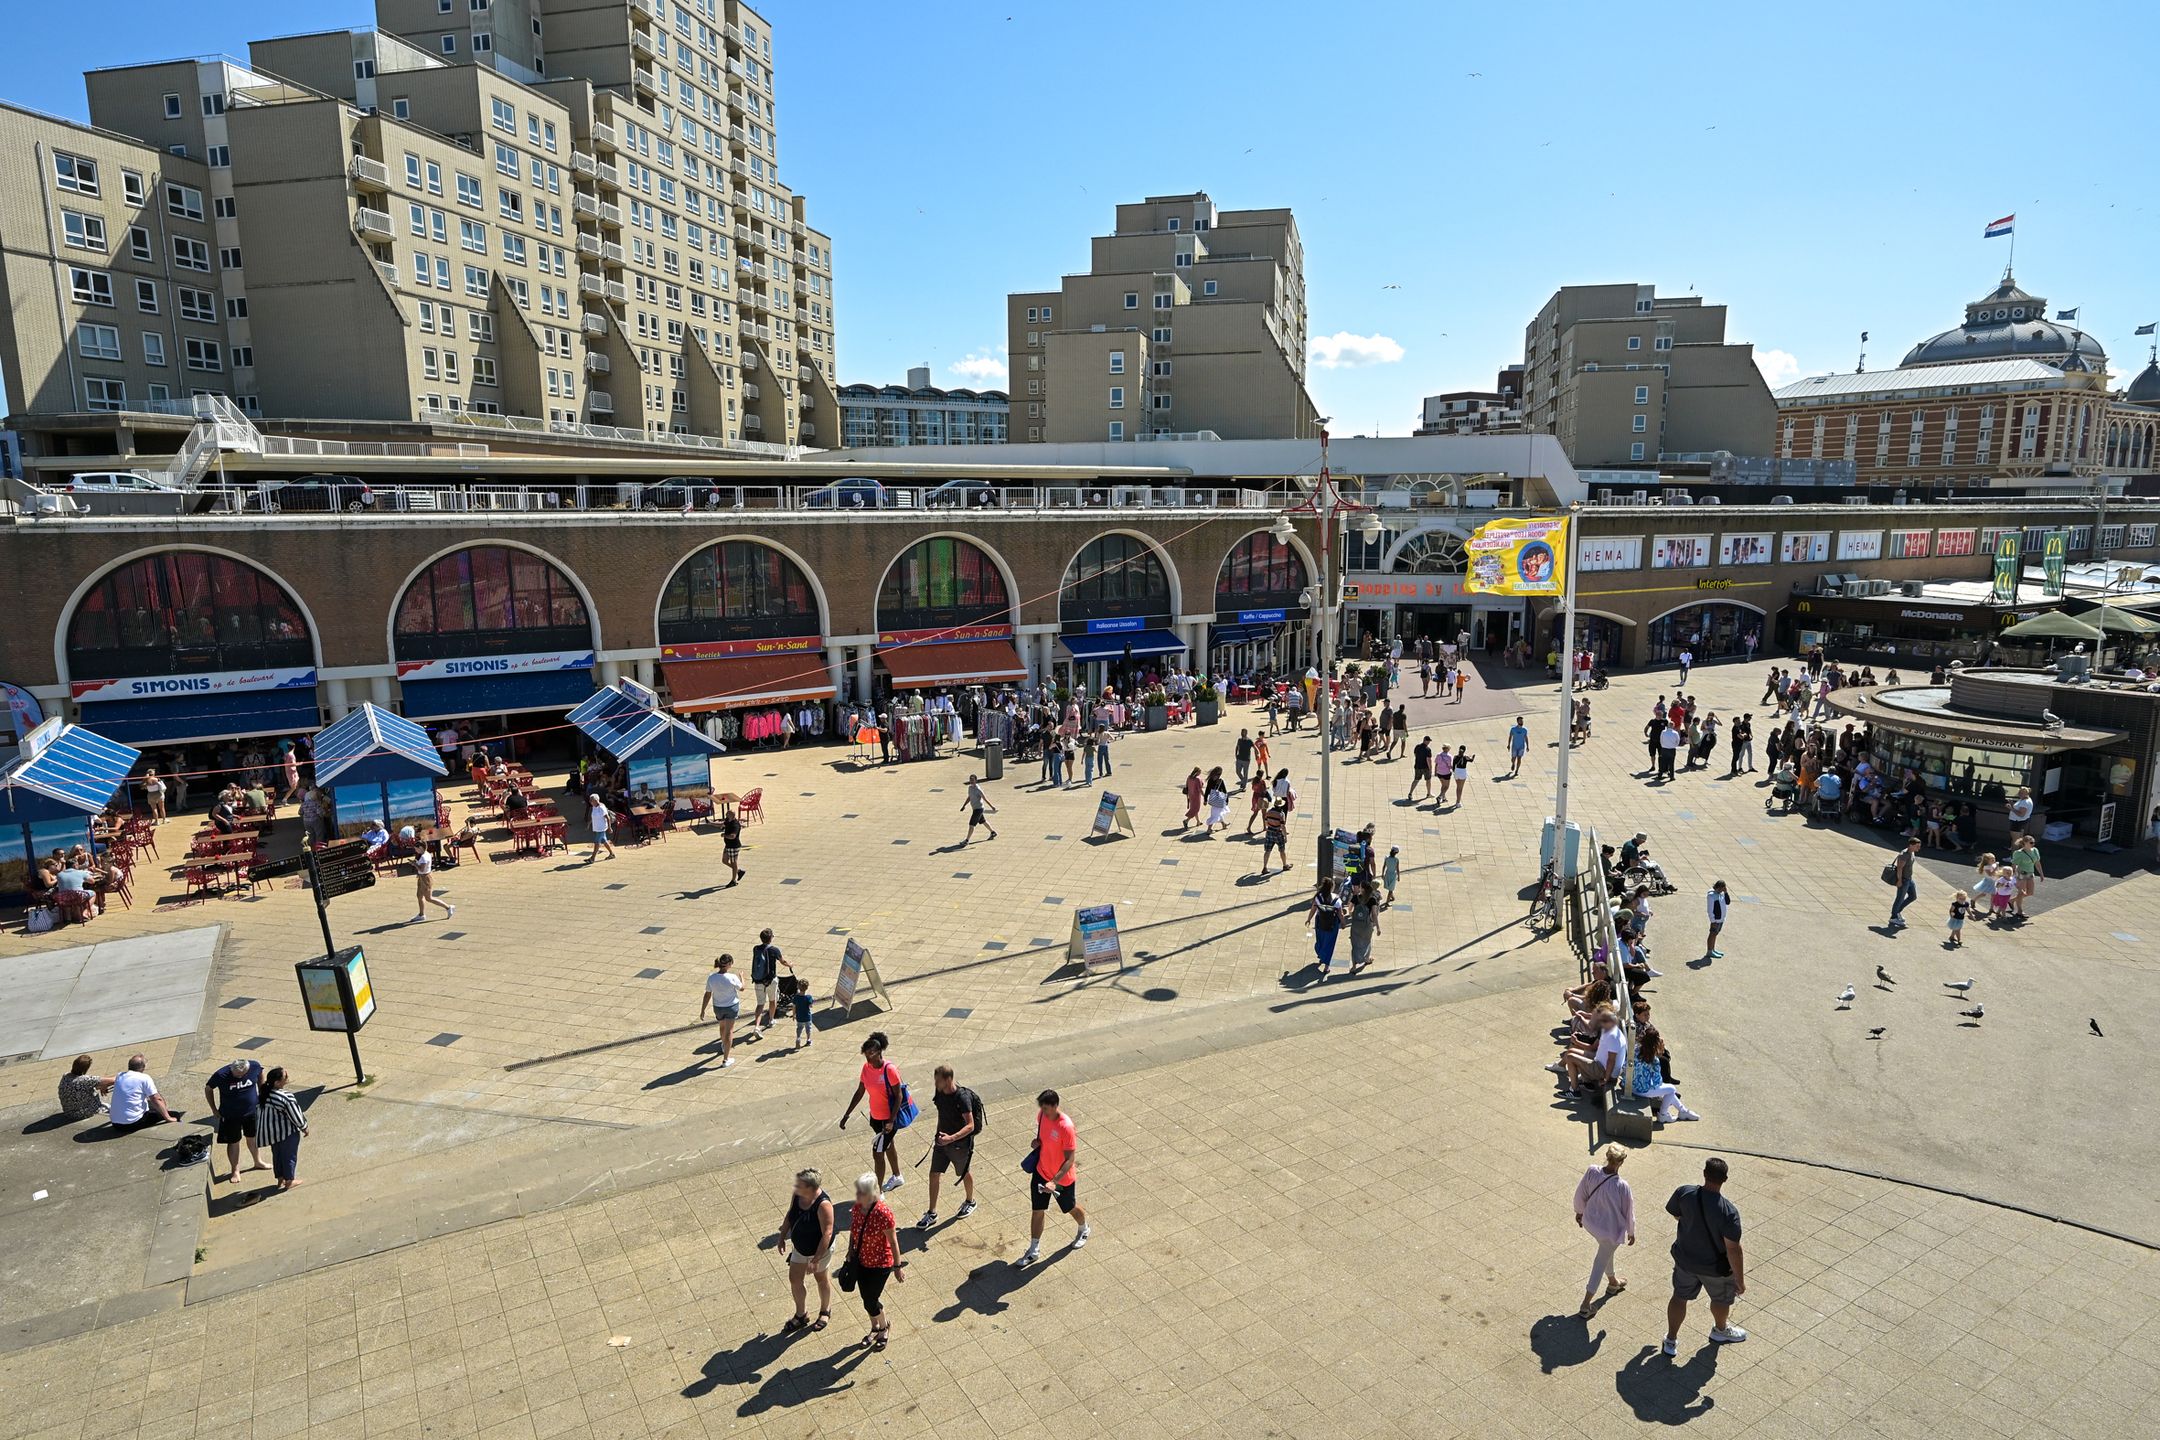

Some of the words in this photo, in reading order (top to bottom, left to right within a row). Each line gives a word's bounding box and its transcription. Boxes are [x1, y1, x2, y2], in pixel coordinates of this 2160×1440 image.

[1848, 543, 1875, 551] HEMA
[1584, 550, 1622, 562] HEMA
[1698, 578, 1733, 590] Intertoys
[1900, 609, 1964, 621] McDonald's
[445, 659, 509, 674] SIMONIS
[532, 655, 560, 666] boulevard
[132, 677, 210, 694] SIMONIS
[227, 678, 235, 686] de
[239, 673, 274, 686] boulevard
[1964, 736, 2025, 749] MILKSHAKE
[230, 1079, 253, 1091] FILA
